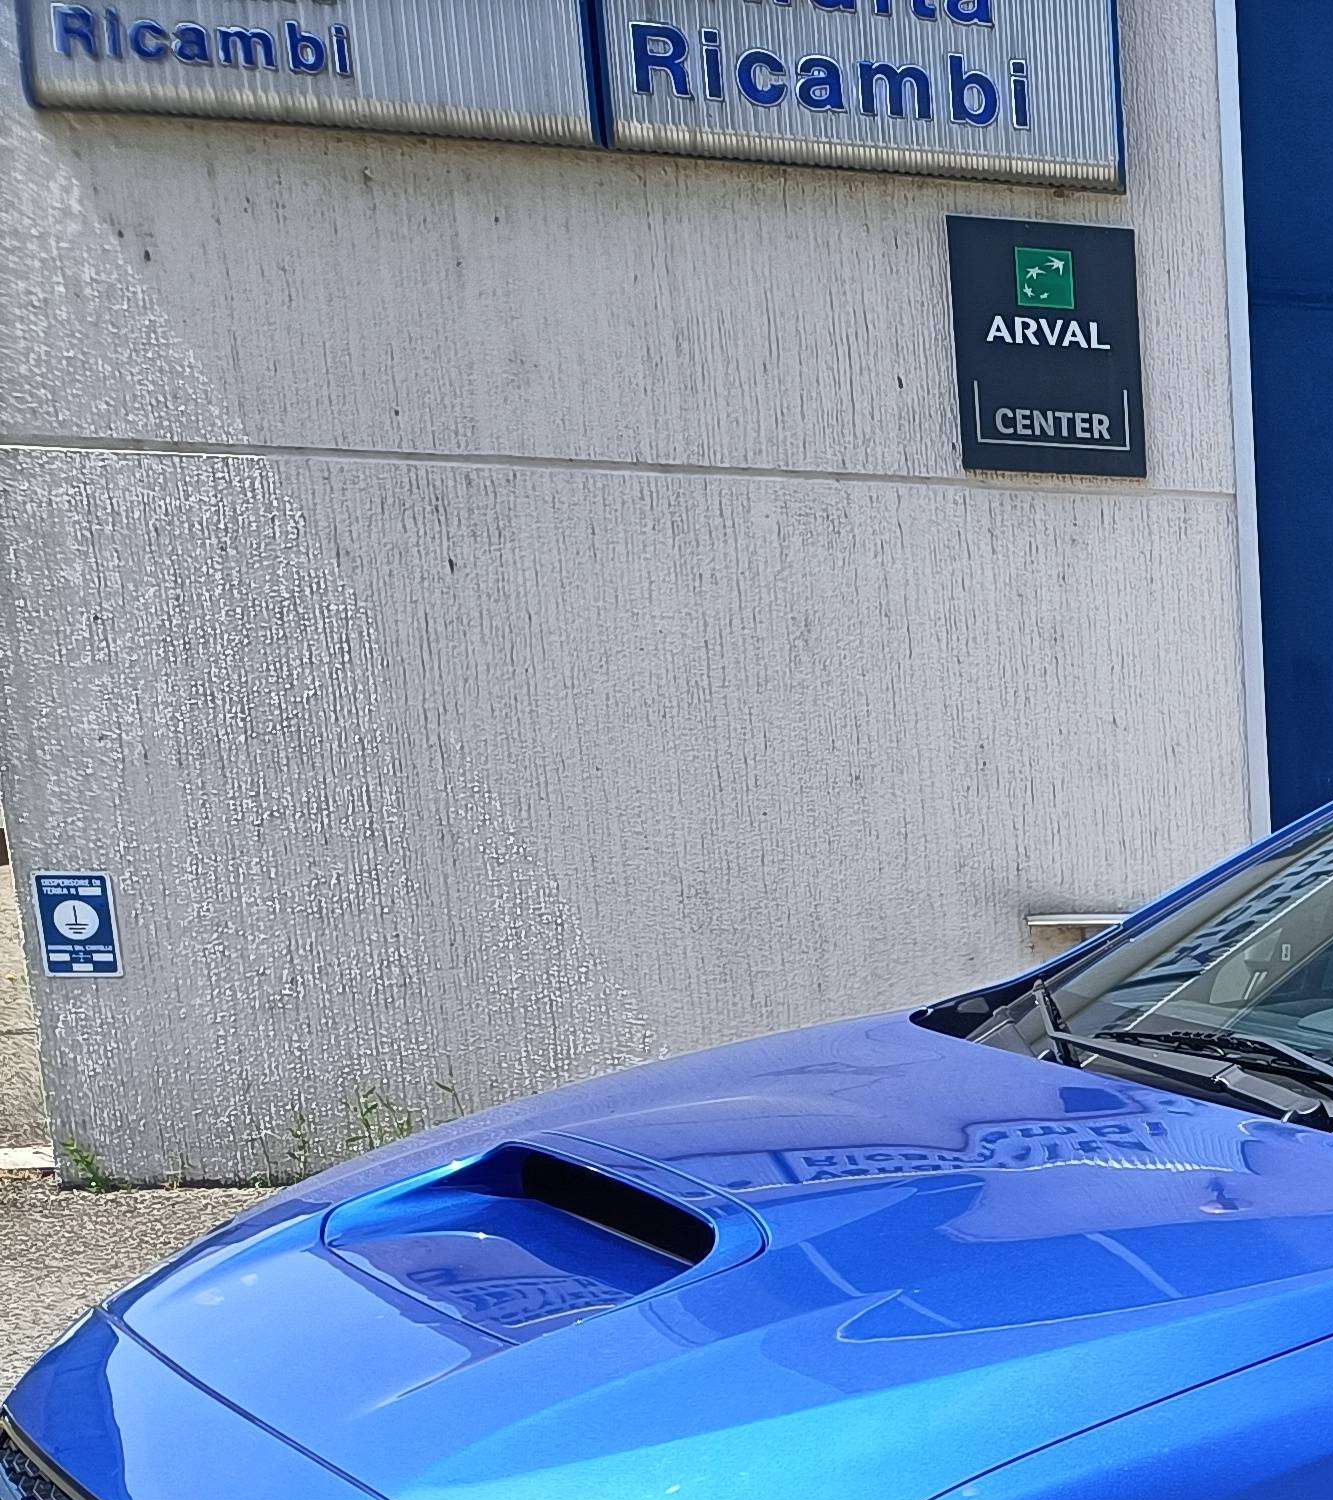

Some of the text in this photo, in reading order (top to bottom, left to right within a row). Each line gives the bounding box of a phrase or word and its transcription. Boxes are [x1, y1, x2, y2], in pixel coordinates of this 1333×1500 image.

[51, 3, 350, 75] Ricambi
[629, 21, 1030, 130] Ricambi
[986, 315, 1111, 349] ARVAL
[995, 407, 1111, 439] CENTER
